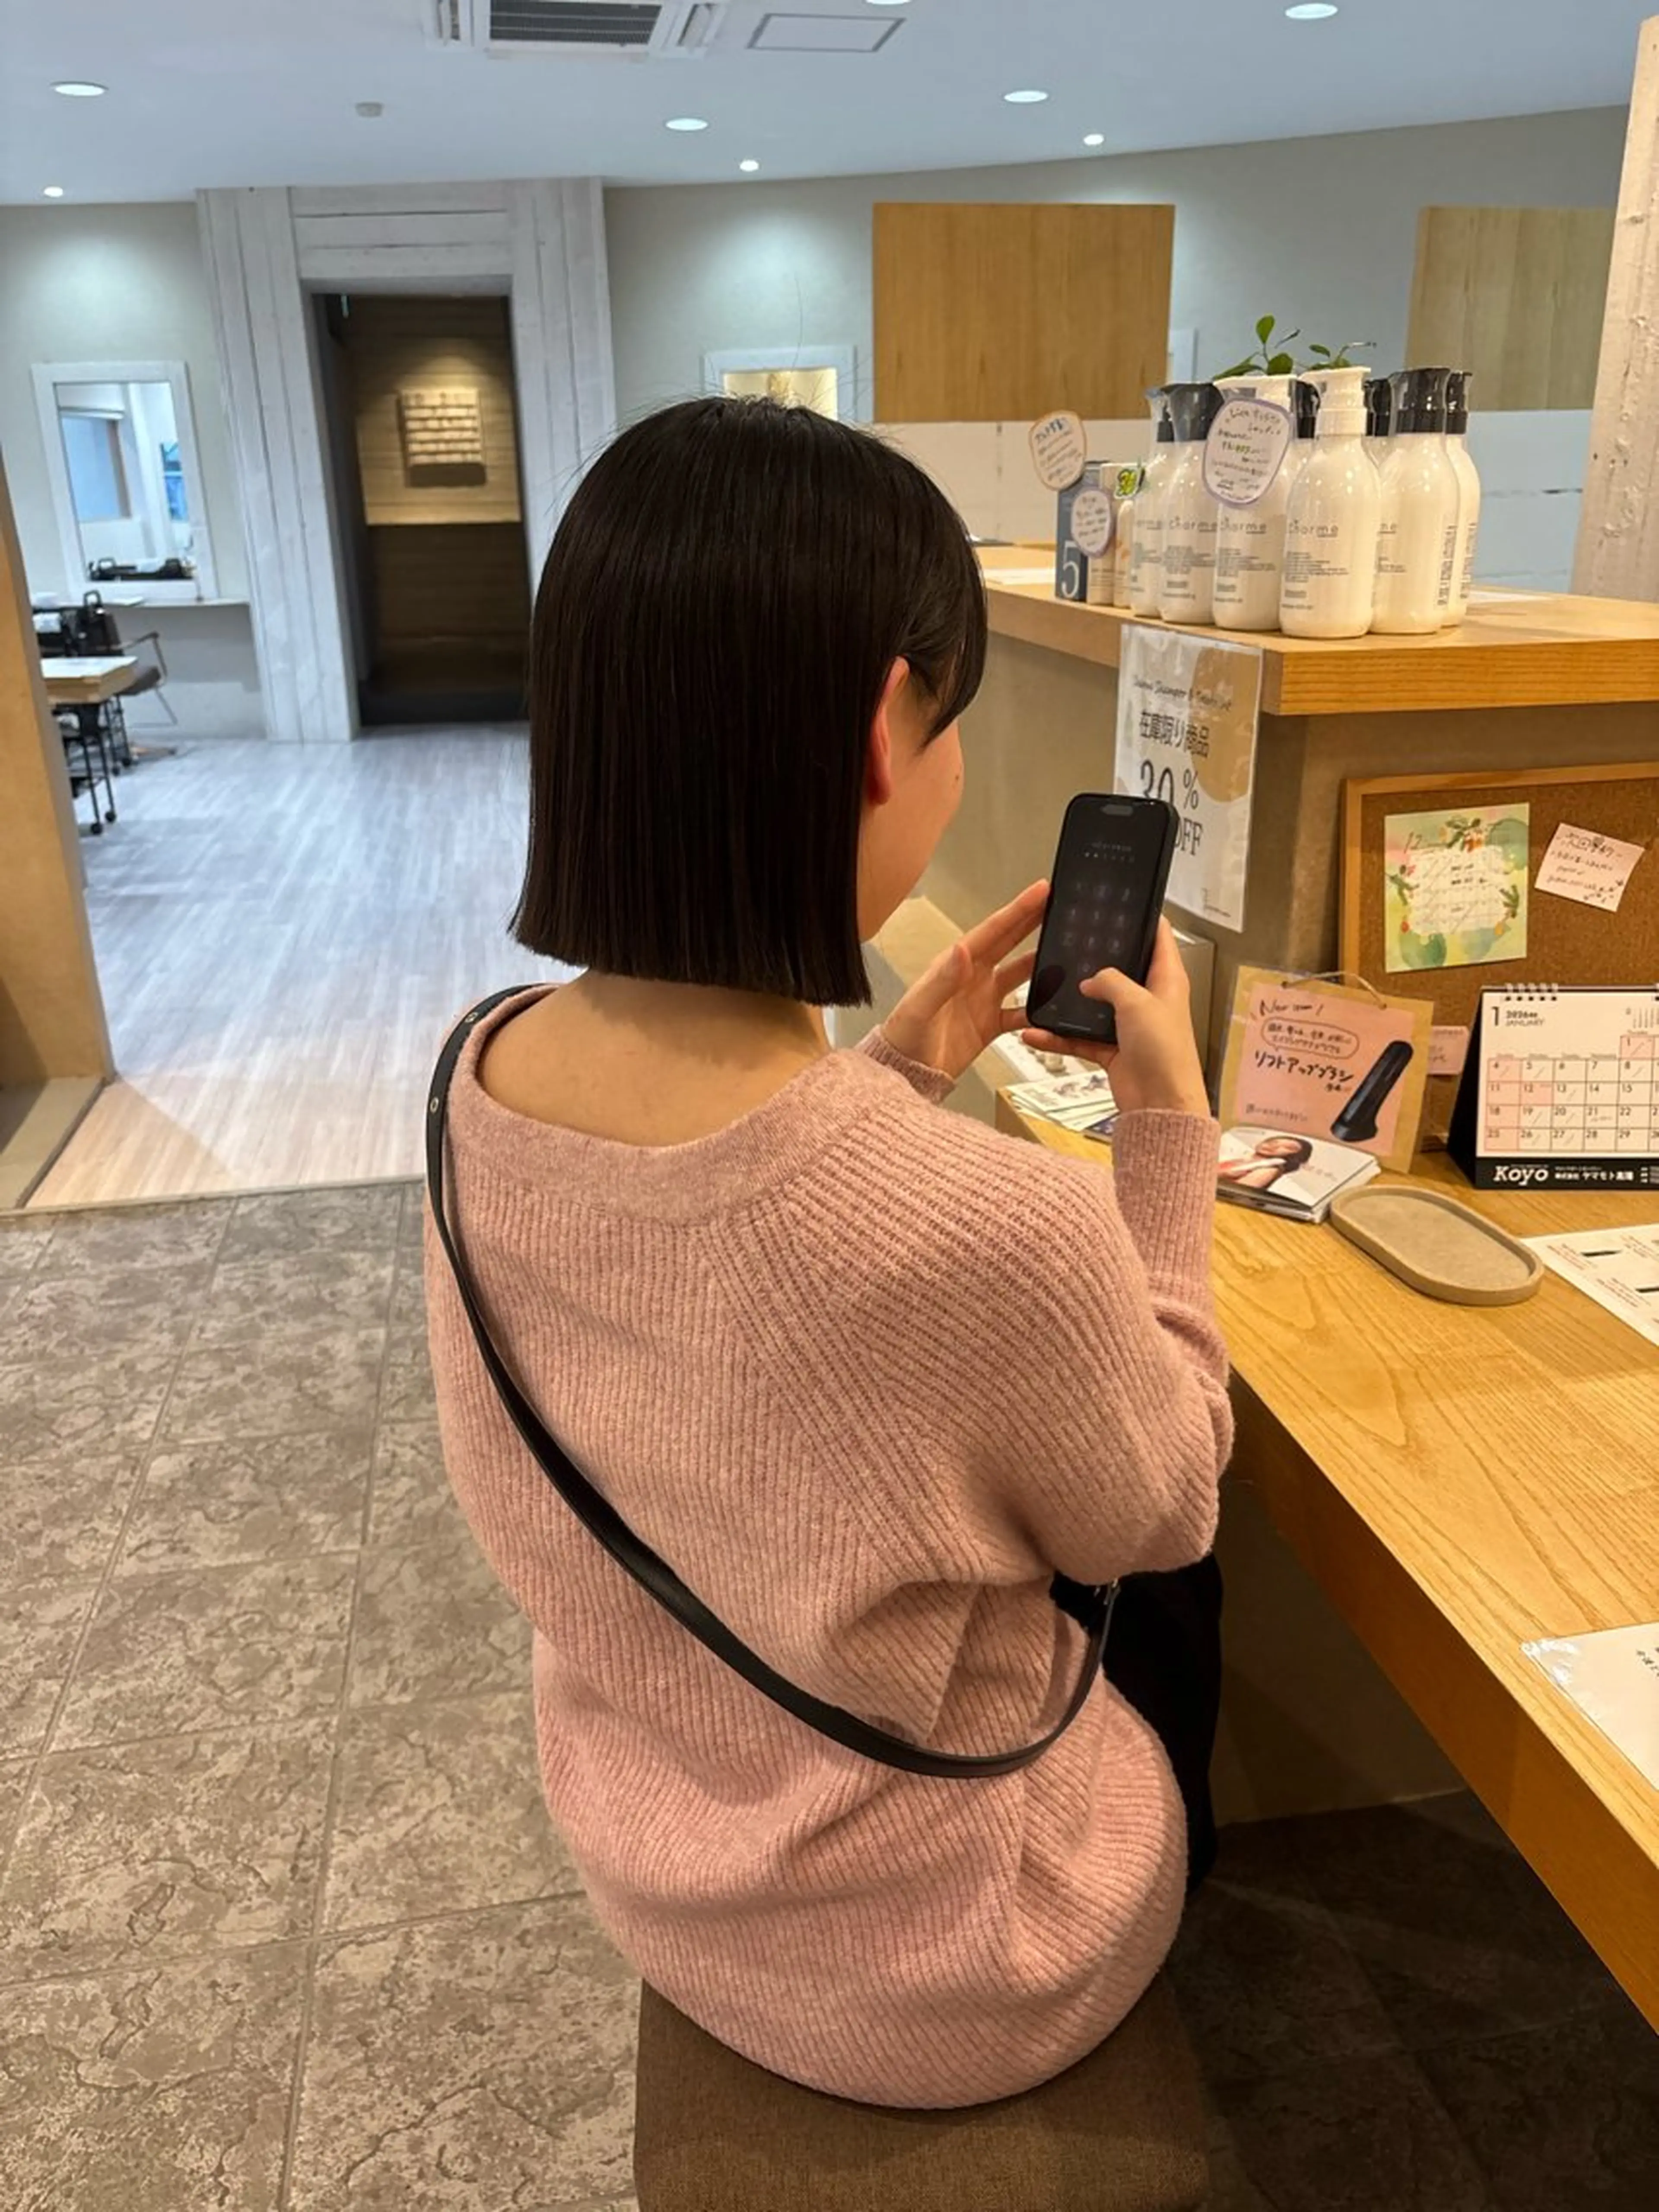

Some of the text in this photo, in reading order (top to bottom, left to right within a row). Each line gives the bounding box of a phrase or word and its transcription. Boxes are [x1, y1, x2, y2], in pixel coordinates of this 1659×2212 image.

[1061, 541, 1079, 597] 5
[1491, 1006, 1500, 1027] 1
[1592, 1061, 1598, 1070] 7
[1524, 1084, 1533, 1092] 12
[1557, 1084, 1567, 1092] 13
[1589, 1084, 1599, 1092] 14
[1622, 1084, 1632, 1092] 15
[1489, 1107, 1500, 1116] 18
[1523, 1107, 1533, 1116] 19
[1555, 1107, 1567, 1116] 20
[1588, 1107, 1598, 1116] 21
[1619, 1107, 1631, 1116] 22
[1521, 1129, 1533, 1138] 26
[1553, 1130, 1565, 1139] 27
[1586, 1130, 1598, 1138] 28
[1619, 1130, 1631, 1139] 29
[1493, 1166, 1549, 1186] Koyo
